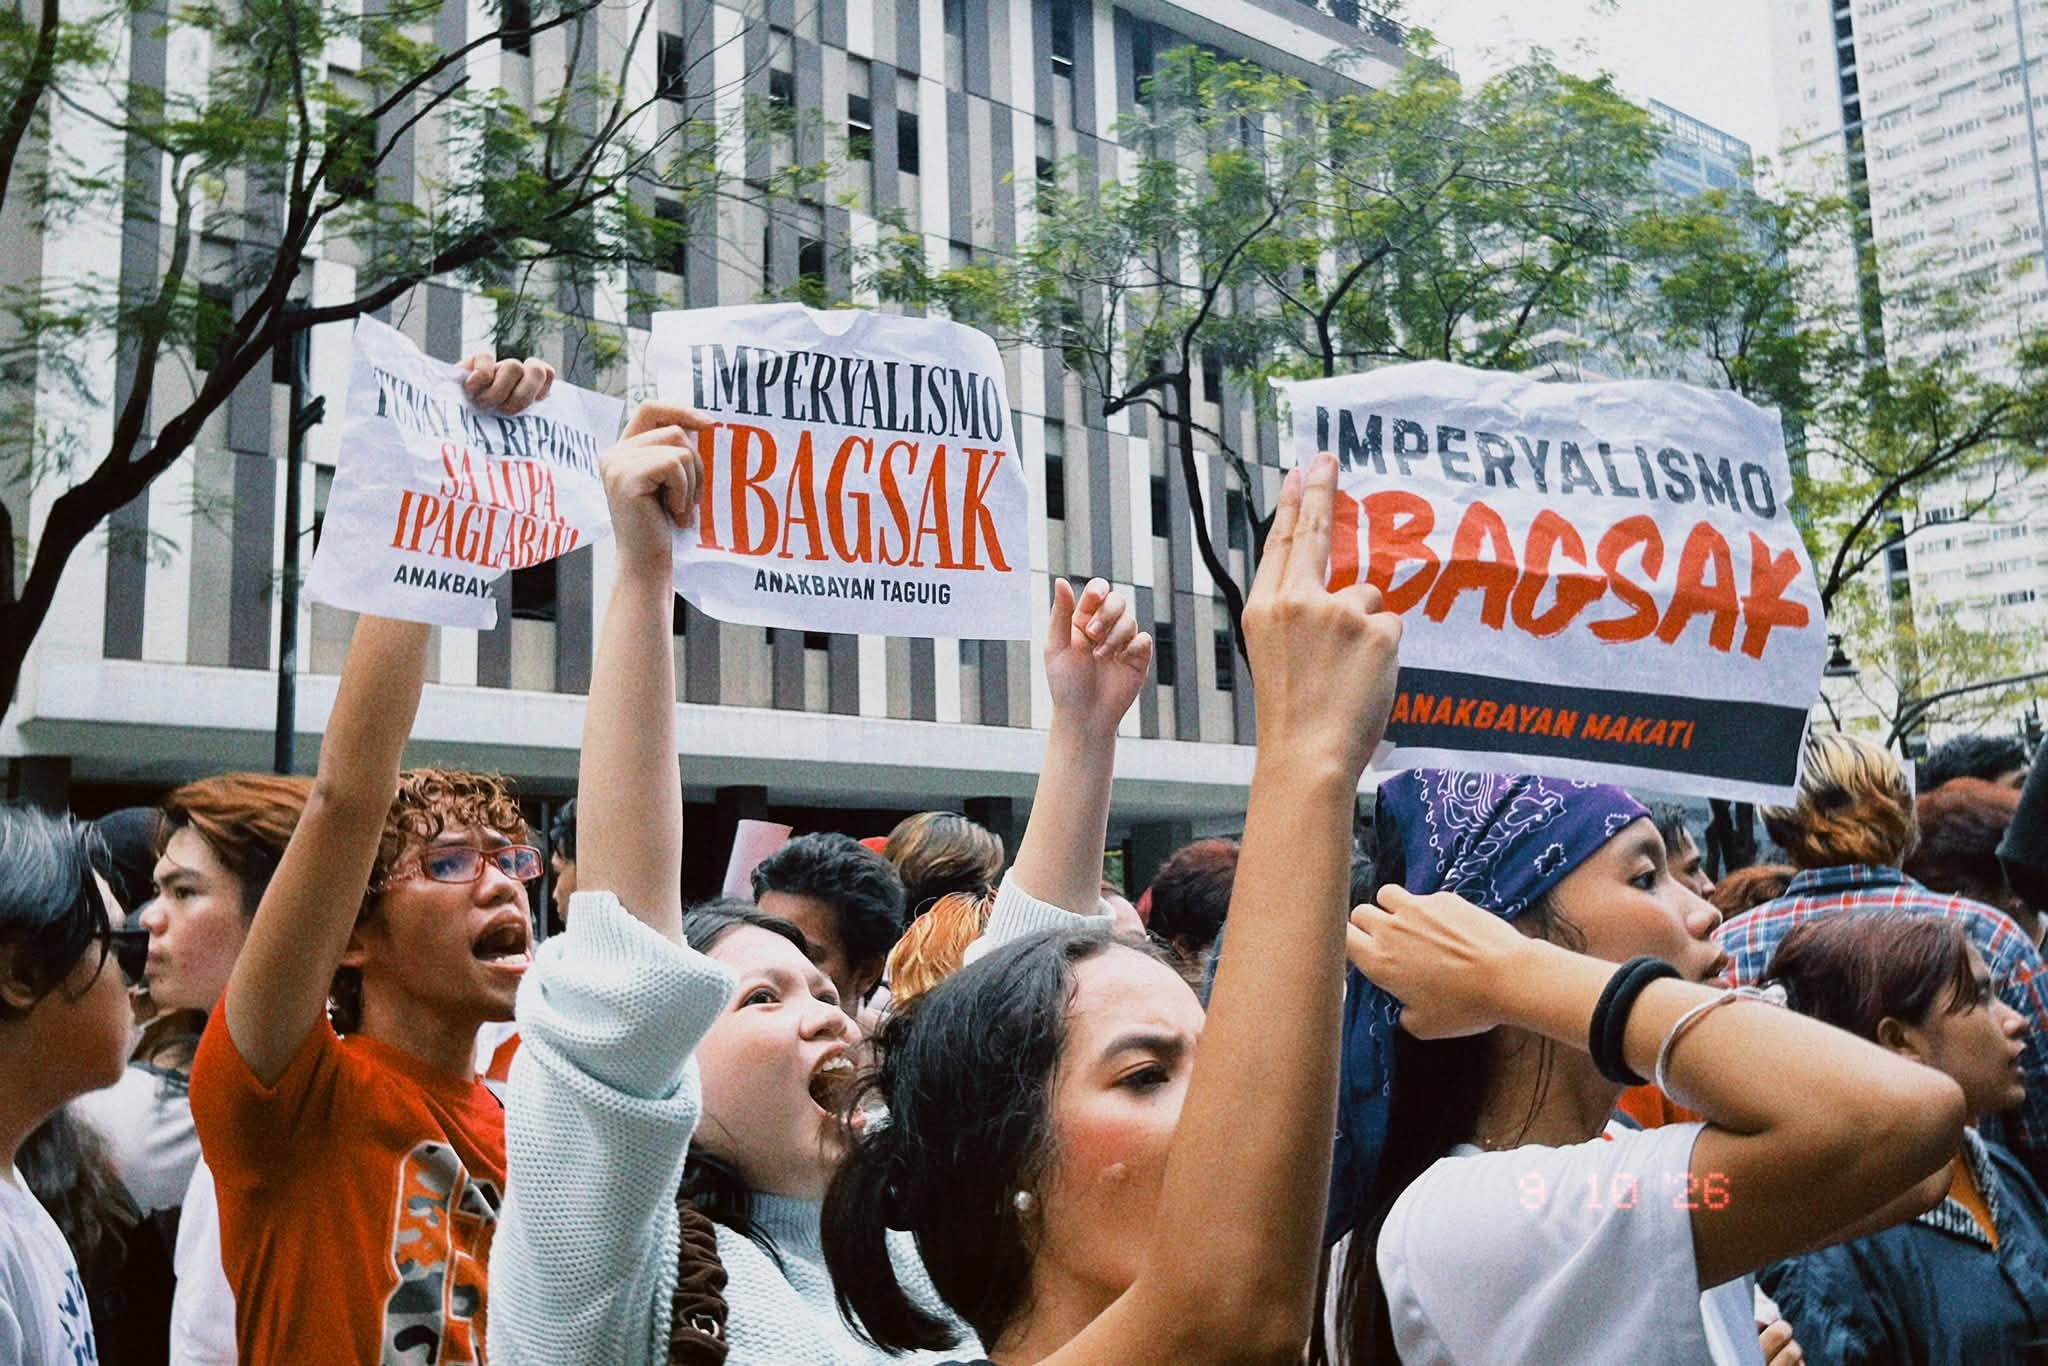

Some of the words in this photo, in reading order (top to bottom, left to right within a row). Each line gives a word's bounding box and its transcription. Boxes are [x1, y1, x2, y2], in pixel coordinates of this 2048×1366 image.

[459, 403, 494, 455] NA
[690, 344, 1002, 442] IMPERYALISMO
[440, 441, 480, 504] SA
[486, 457, 566, 525] LUPA,
[696, 421, 1013, 573] IBAGSAK
[1315, 405, 1777, 520] IMPERYALISMO
[393, 565, 493, 598] ANAKBAY
[754, 569, 875, 601] ANAKBAYAN
[881, 580, 951, 605] TAGUIG
[1325, 489, 1809, 661] IBAGSAK
[1391, 691, 1577, 739] ANAKBAYAN
[1581, 713, 1696, 750] MAKATI
